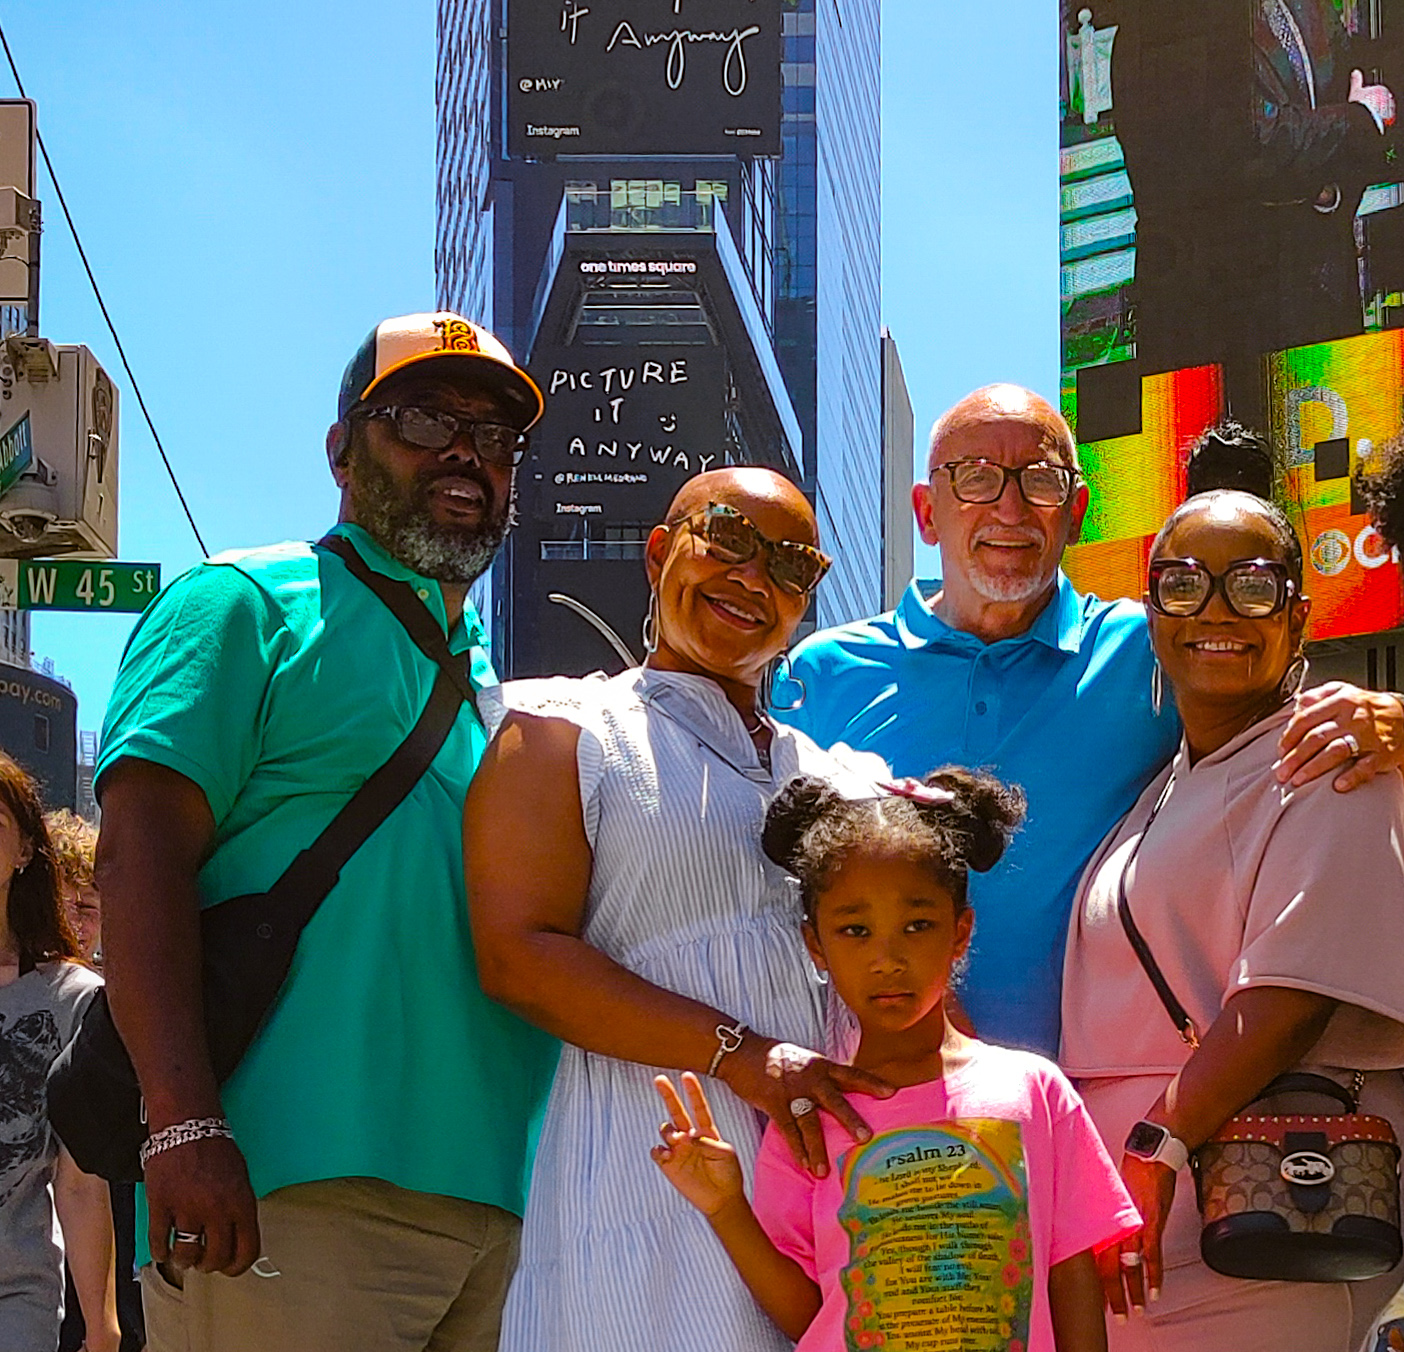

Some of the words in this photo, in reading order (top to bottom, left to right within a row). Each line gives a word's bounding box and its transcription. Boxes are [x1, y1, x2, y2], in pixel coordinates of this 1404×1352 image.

[606, 21, 761, 96] Anyway
[526, 123, 582, 139] Instagram
[580, 262, 607, 273] one
[608, 260, 647, 274] times
[648, 261, 698, 276] square
[549, 360, 689, 395] PICTURE
[569, 437, 716, 474] ANYWAY
[555, 502, 603, 516] Instagram
[27, 567, 57, 604] W
[75, 568, 115, 607] 45
[132, 569, 154, 594] St
[946, 1144, 966, 1158] 23
